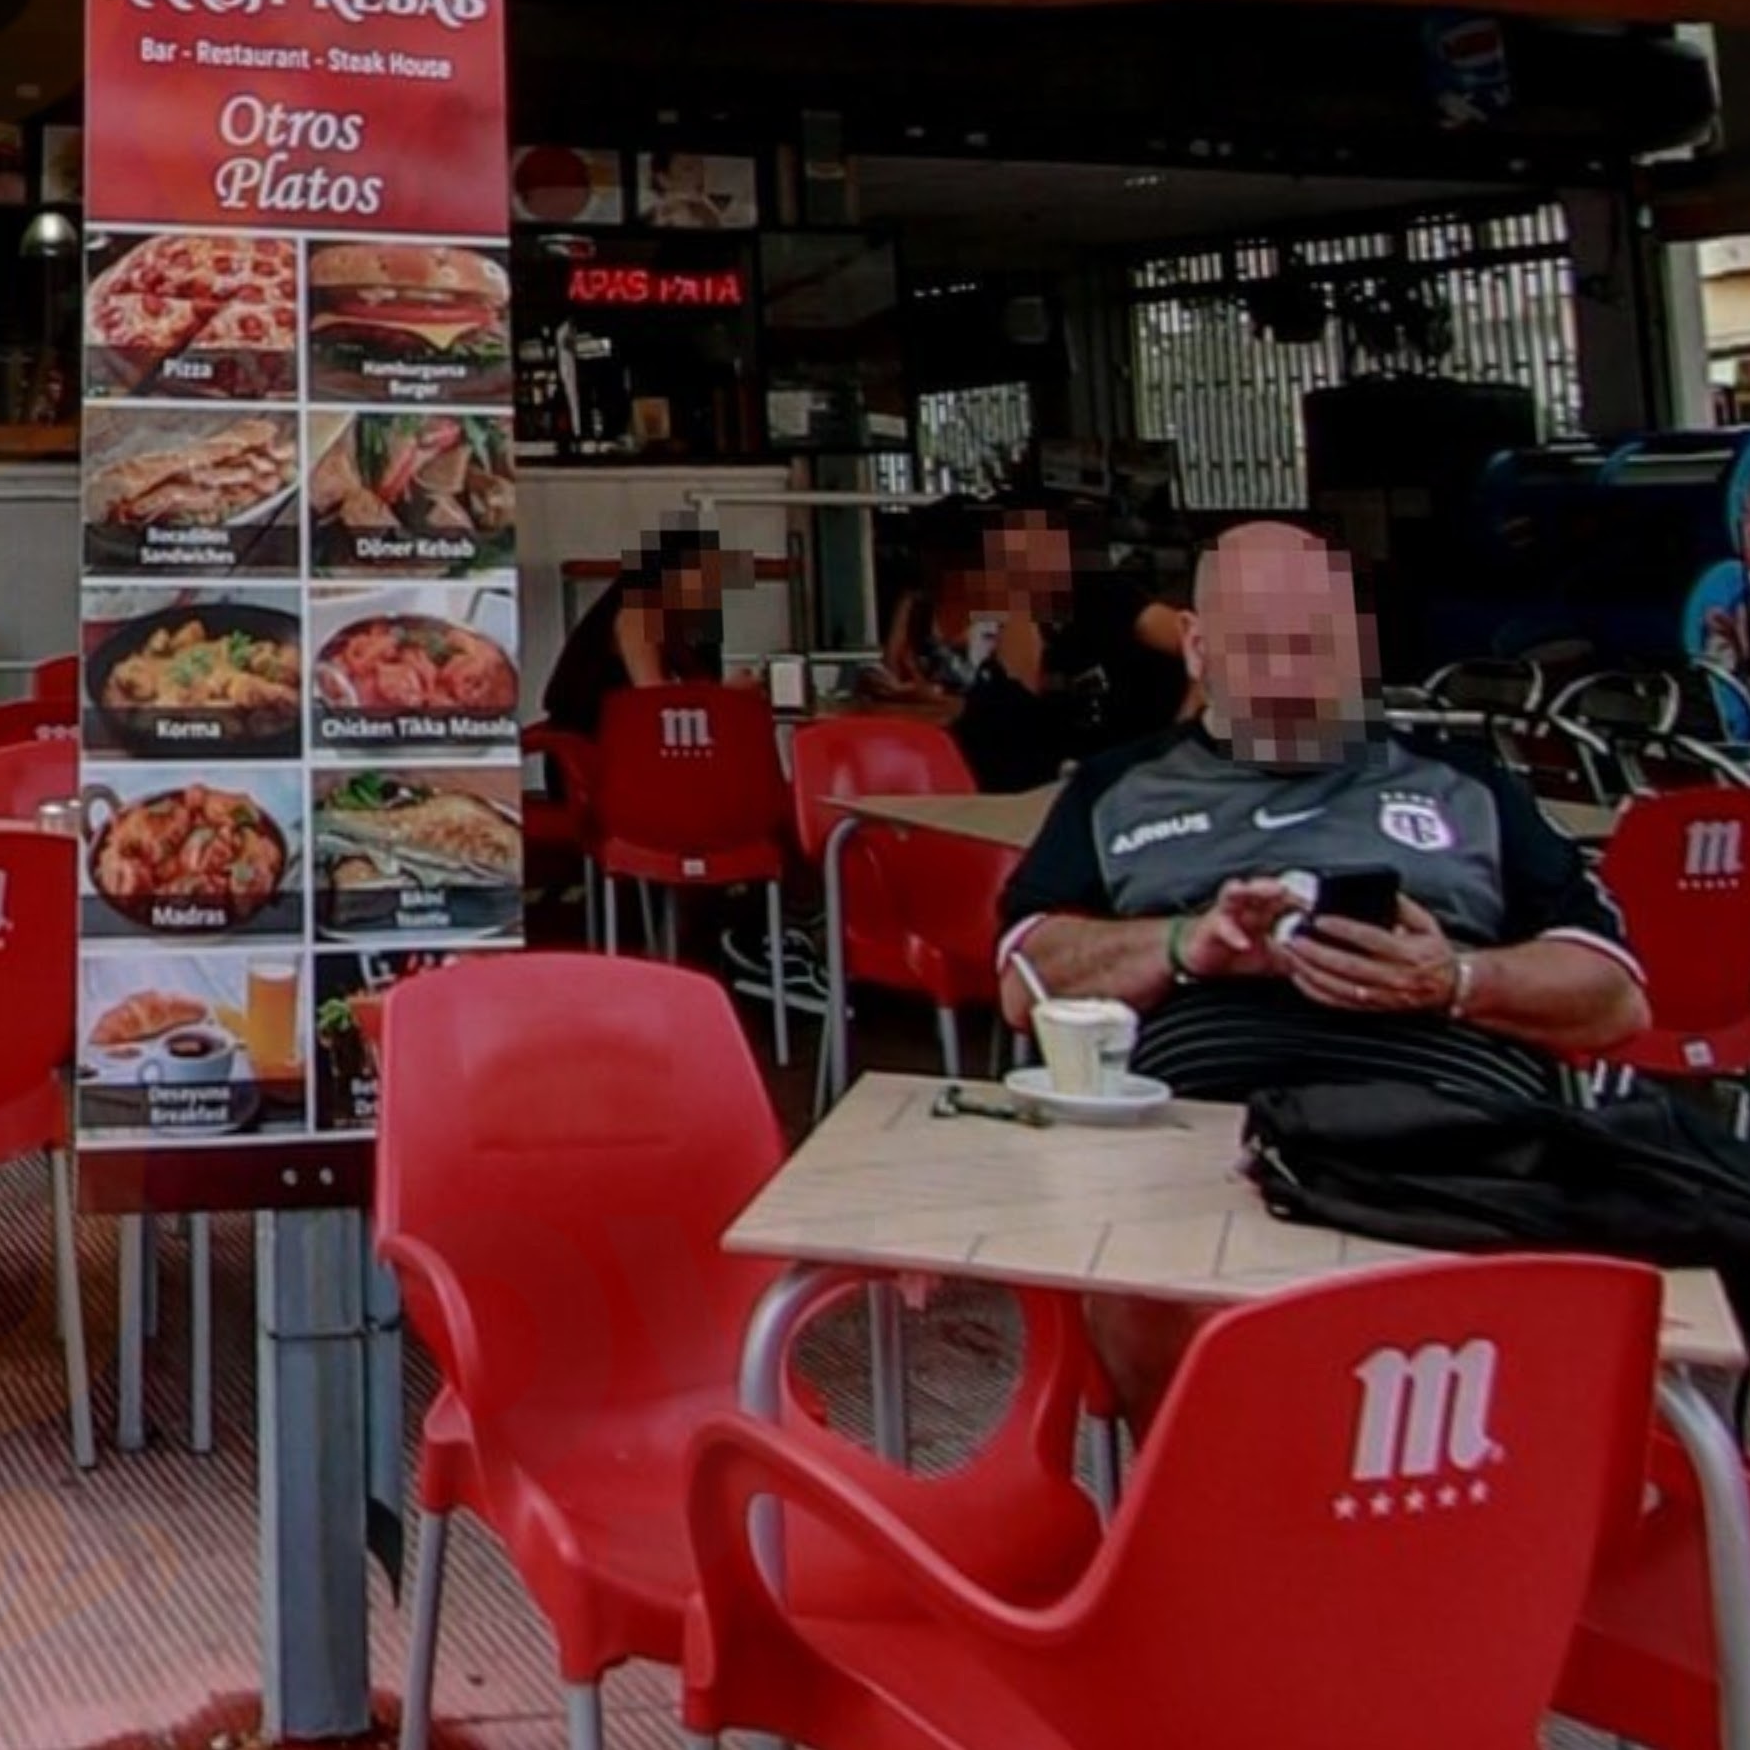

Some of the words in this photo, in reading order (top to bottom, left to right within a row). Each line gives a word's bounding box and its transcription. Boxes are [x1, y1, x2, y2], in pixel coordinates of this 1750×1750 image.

[140, 36, 178, 63] Bar
[196, 40, 310, 71] Restaurant
[328, 47, 386, 77] Steak
[390, 52, 453, 80] House
[219, 94, 365, 151] Otros
[214, 153, 384, 216] Platos
[162, 358, 214, 380] Pizza
[388, 380, 441, 400] Burger
[140, 546, 236, 565] Sandwiches
[356, 536, 414, 558] Döner
[417, 537, 476, 559] Kebab
[156, 720, 222, 740] Korma
[321, 717, 394, 739] Chicken
[397, 718, 446, 738] Tikka
[450, 718, 518, 738] Masala
[1111, 812, 1211, 855] AIRBUS
[151, 905, 226, 927] Madras
[149, 1103, 230, 1124] Breakfast
